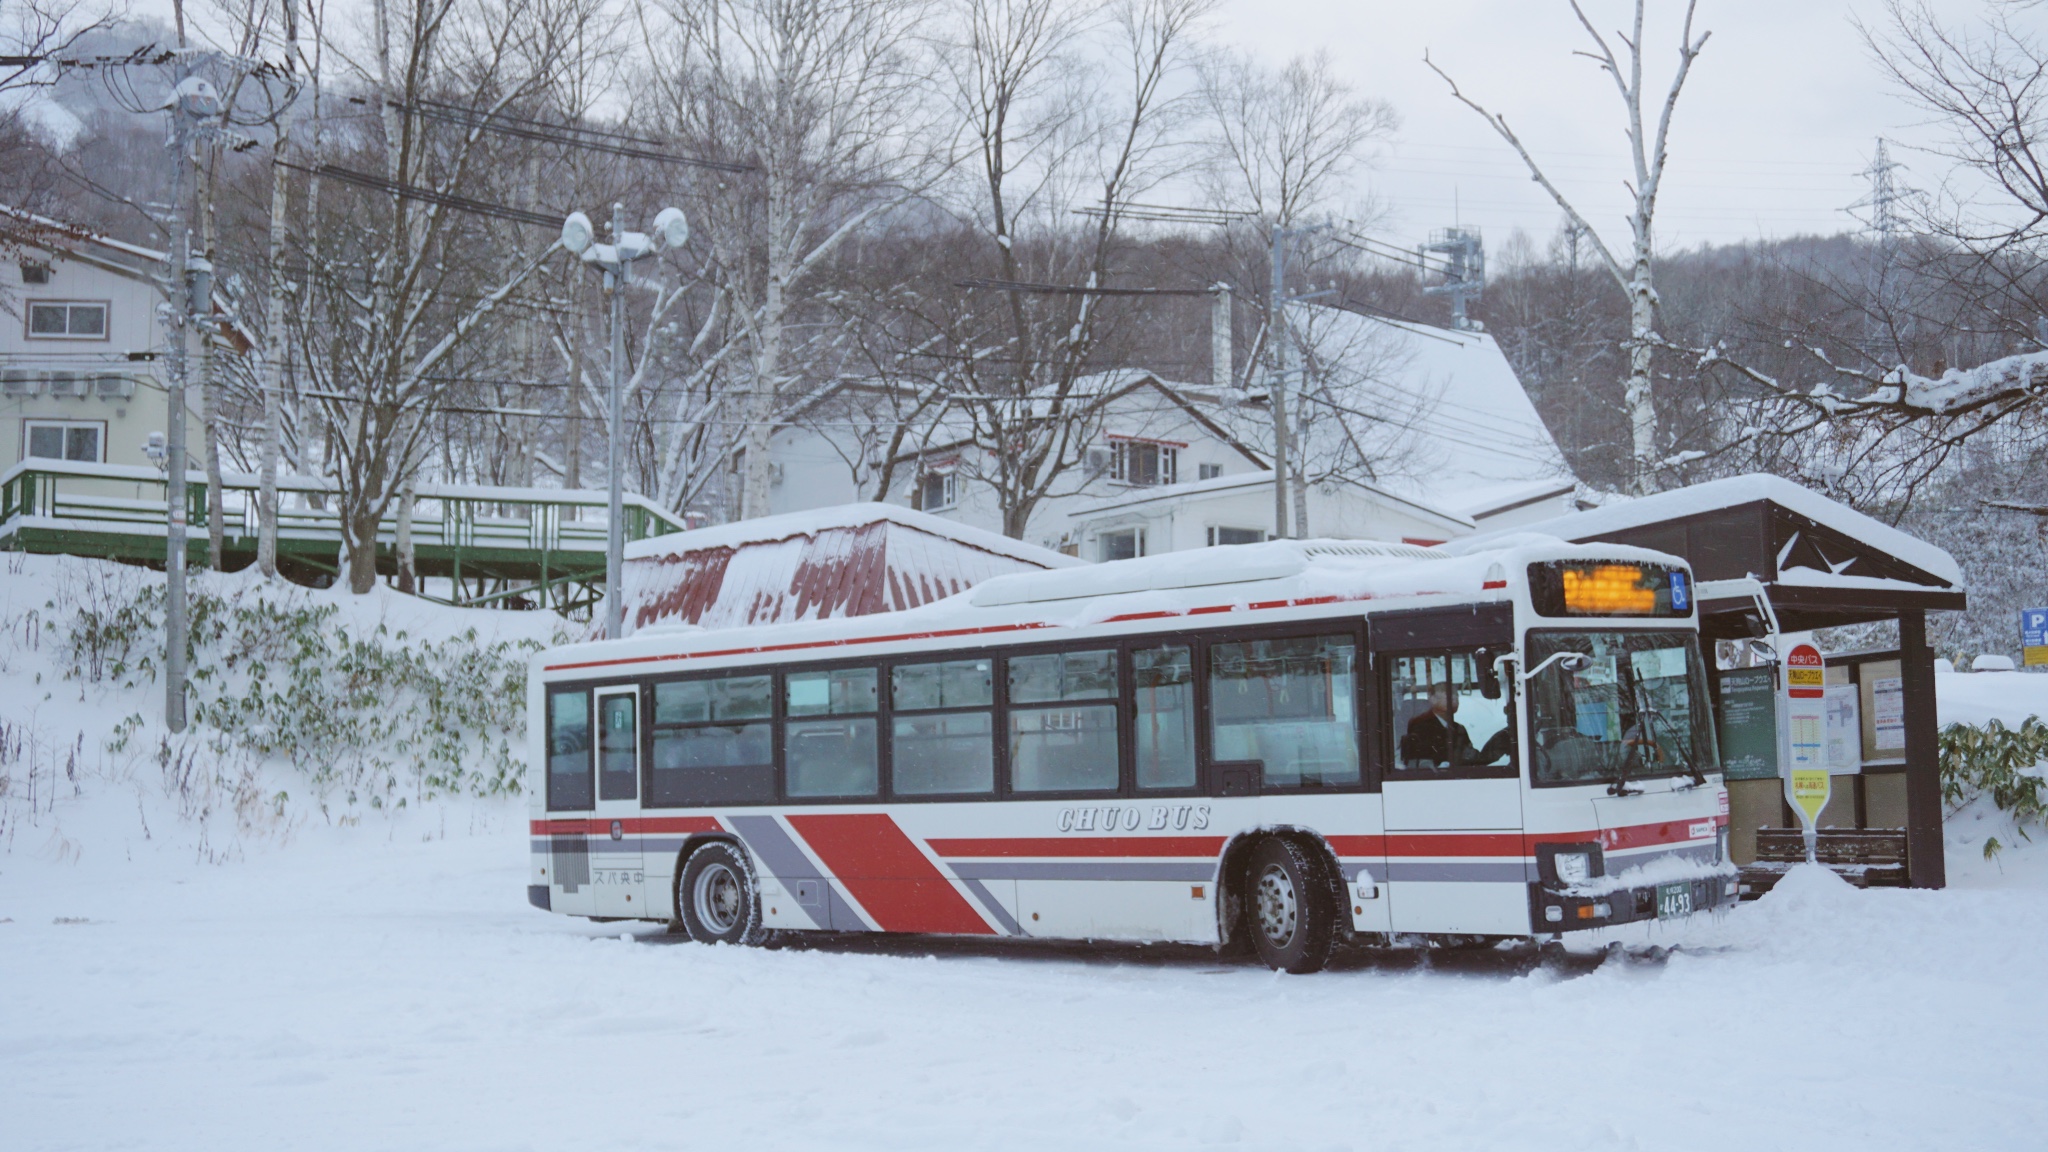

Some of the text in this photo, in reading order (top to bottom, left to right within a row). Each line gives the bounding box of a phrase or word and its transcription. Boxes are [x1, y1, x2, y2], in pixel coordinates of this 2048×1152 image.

[2031, 614, 2045, 628] P
[1790, 654, 1819, 665] 中央バス
[1056, 804, 1211, 832] CHUO BUS
